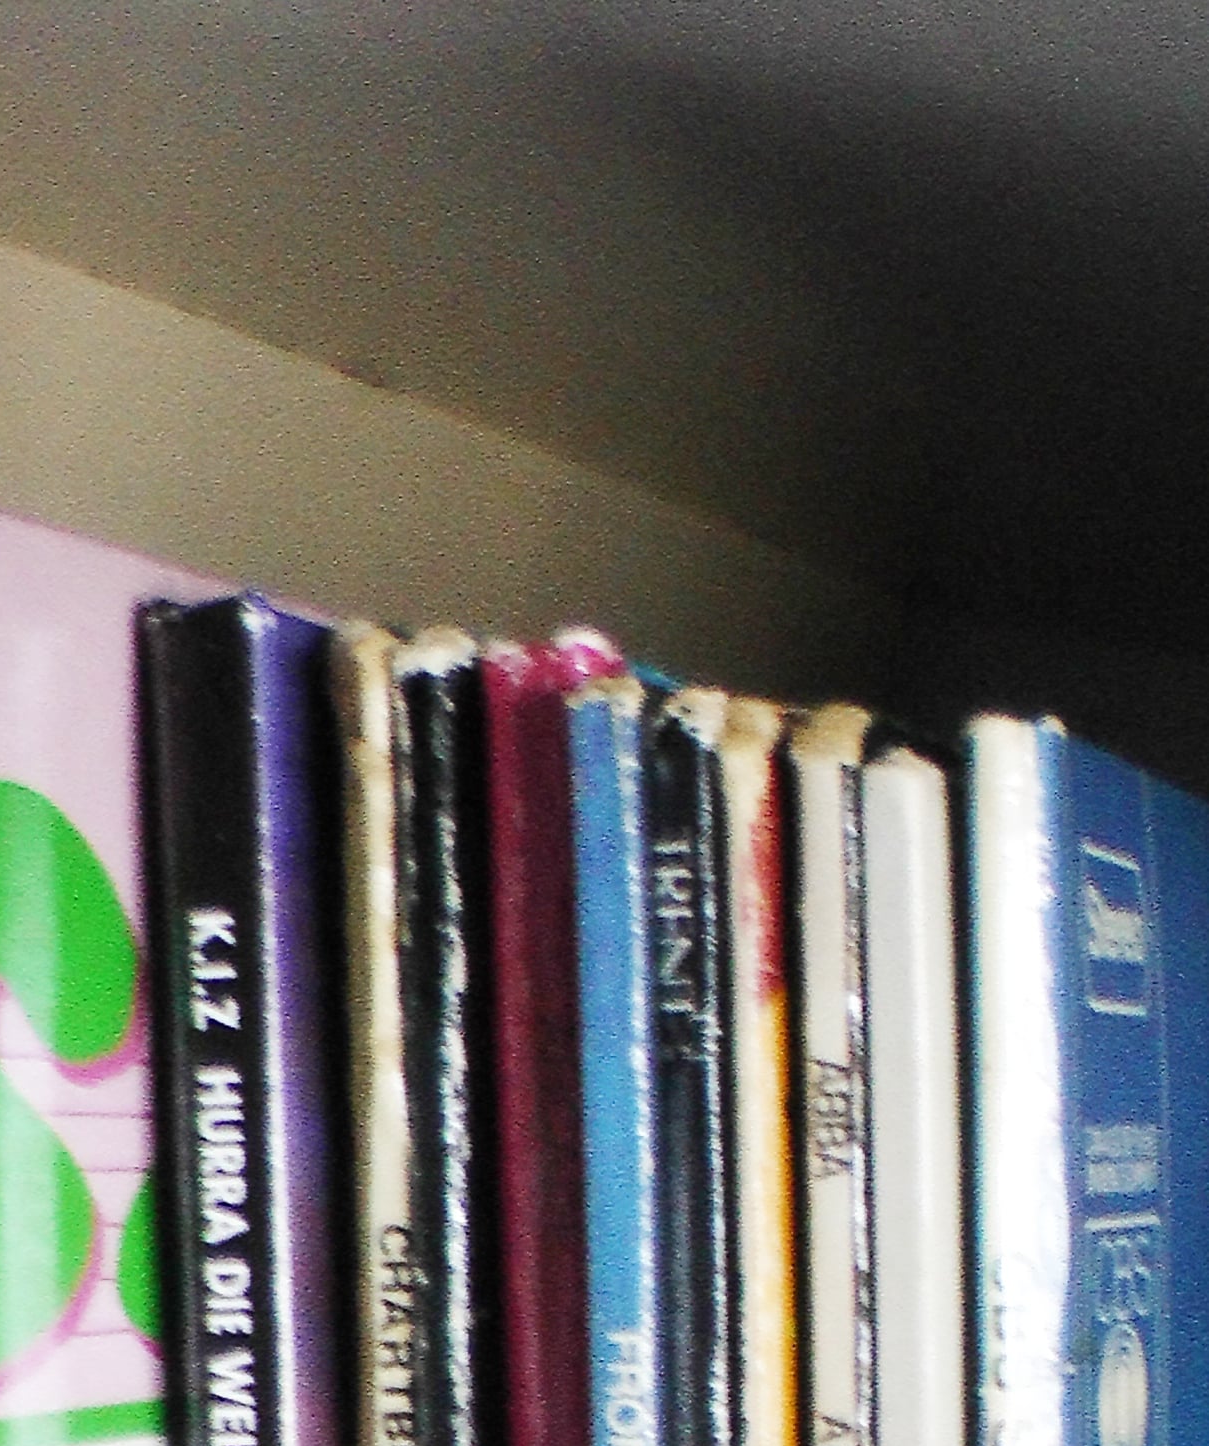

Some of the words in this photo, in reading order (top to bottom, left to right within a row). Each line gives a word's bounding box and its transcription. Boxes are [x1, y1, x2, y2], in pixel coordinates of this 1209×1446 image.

[187, 906, 243, 1032] K.I.Z
[193, 1064, 249, 1246] HURRA
[808, 1058, 857, 1181] ABBA
[202, 1255, 255, 1335] DIE
